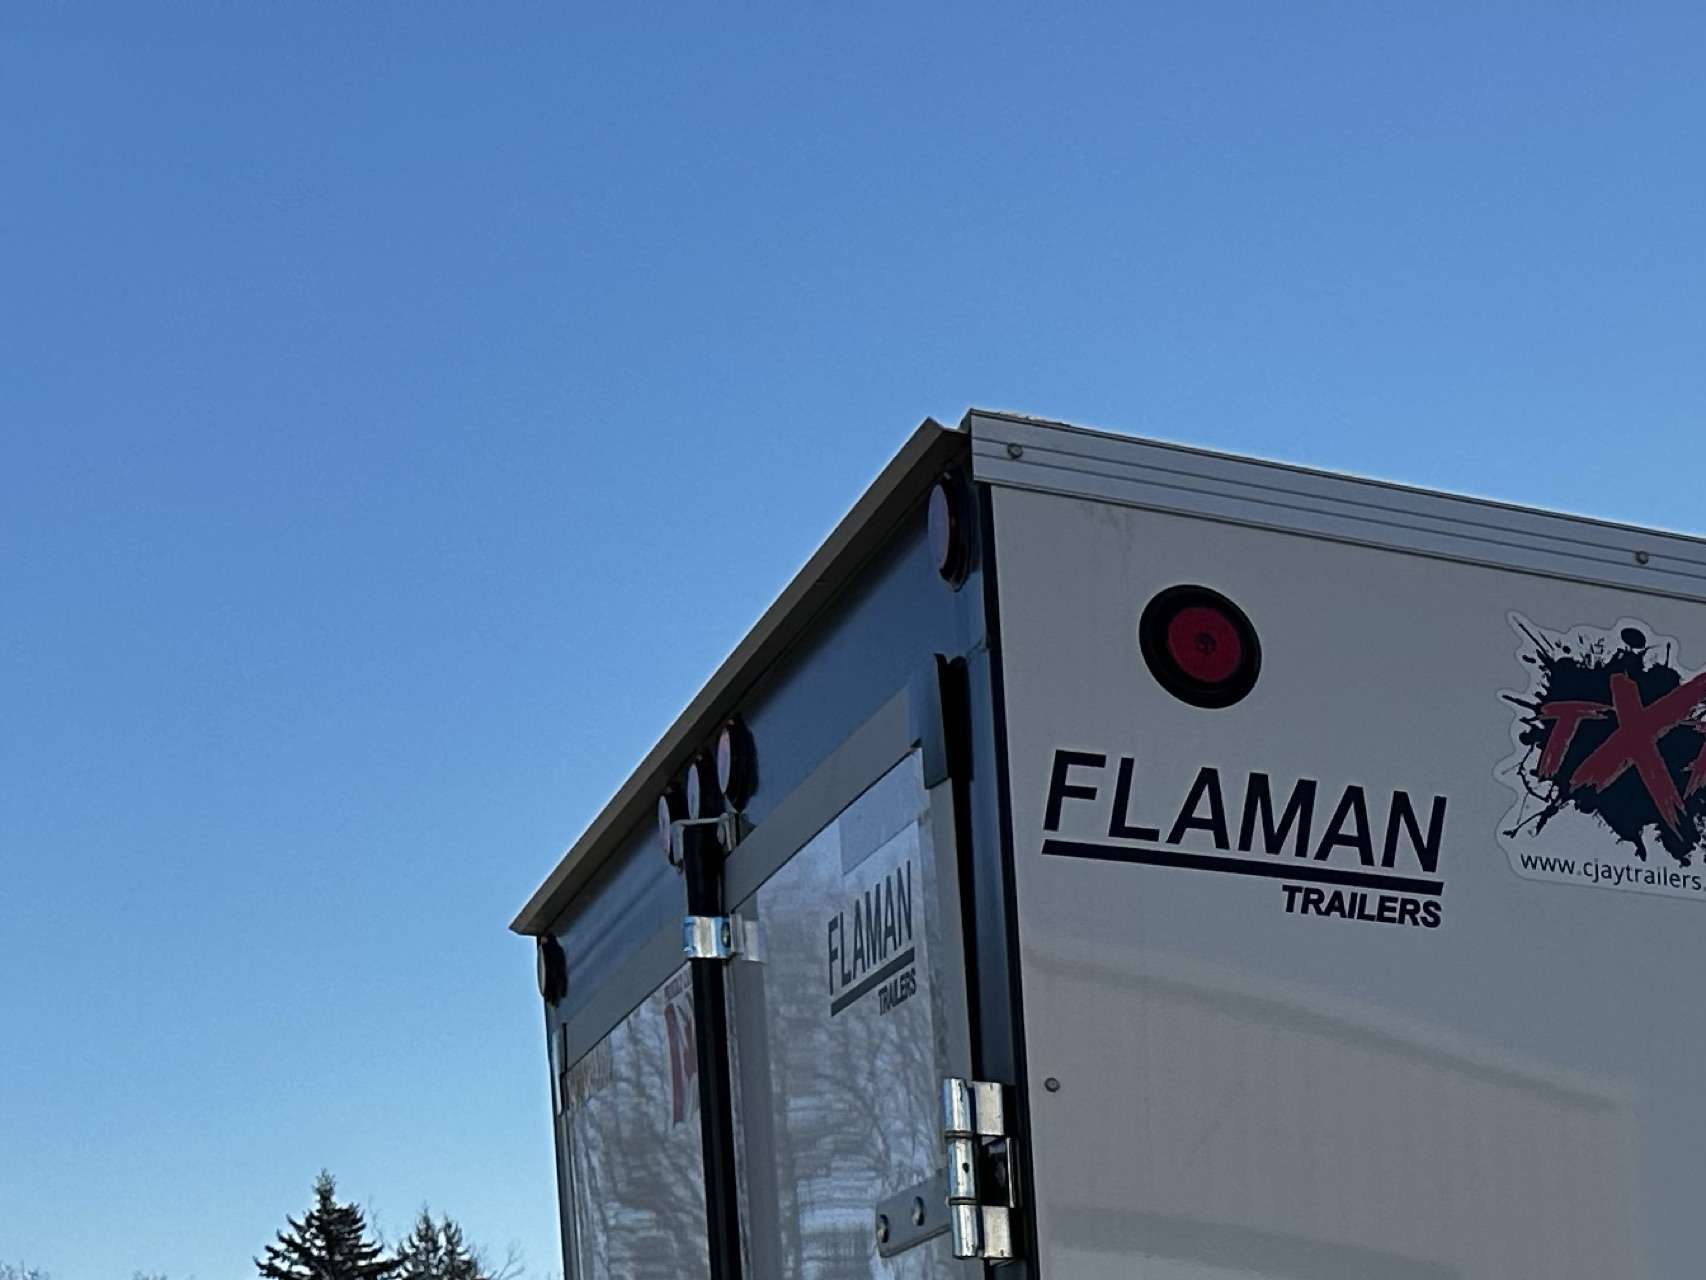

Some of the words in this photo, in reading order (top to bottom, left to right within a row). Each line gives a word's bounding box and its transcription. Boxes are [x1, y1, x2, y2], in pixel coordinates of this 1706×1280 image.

[1043, 749, 1447, 874] FLAMAN
[828, 860, 912, 996] FLAMAN
[1281, 884, 1442, 928] TRAILERS
[877, 967, 916, 1016] TRAILERS
